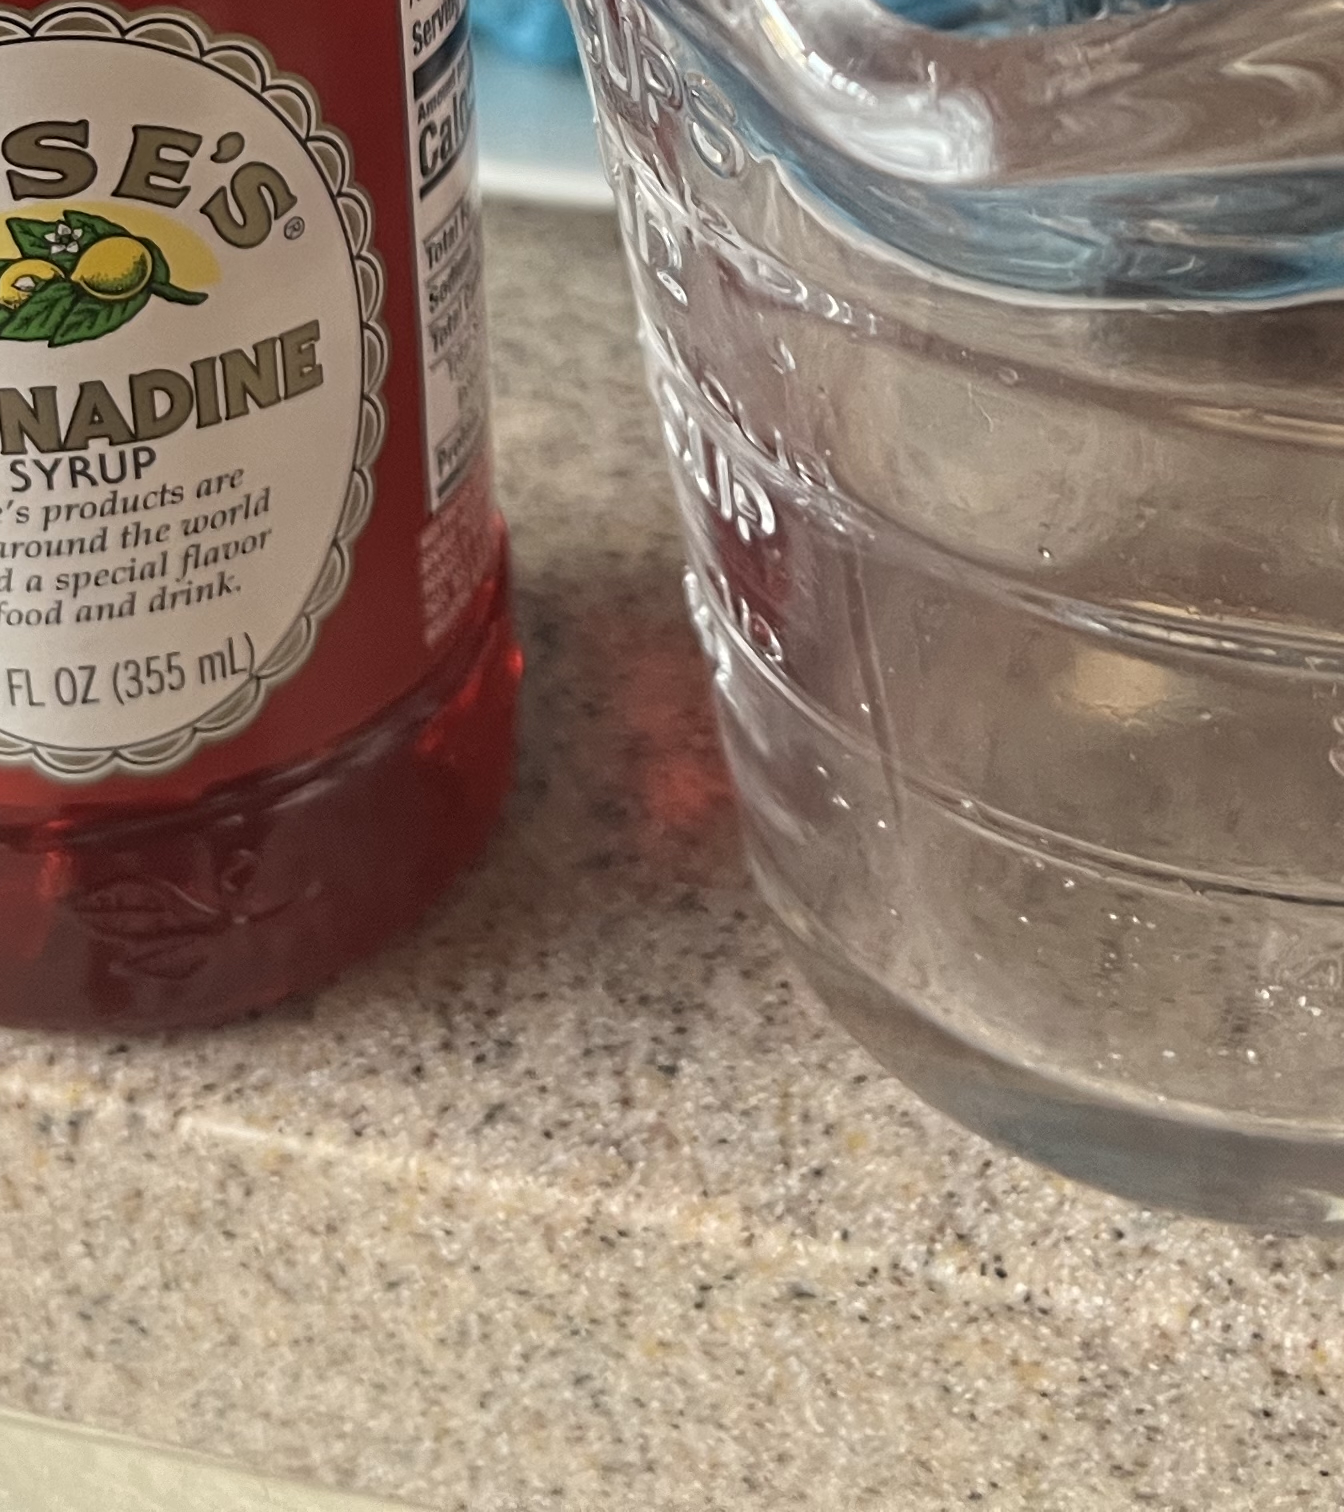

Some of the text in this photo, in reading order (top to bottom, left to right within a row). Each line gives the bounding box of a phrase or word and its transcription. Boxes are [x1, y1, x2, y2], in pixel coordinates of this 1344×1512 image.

[9, 445, 157, 493] SYRUP
[42, 482, 184, 532] products
[195, 467, 245, 500] are
[120, 520, 171, 550] the
[180, 485, 272, 537] world
[25, 572, 43, 593] a
[55, 550, 168, 598] special
[175, 528, 273, 583] flavor
[75, 591, 137, 624] and
[148, 571, 242, 614] drink.
[6, 667, 45, 707] FL
[55, 664, 100, 707] OZ
[112, 651, 186, 706] (355
[198, 631, 256, 685] mL)
